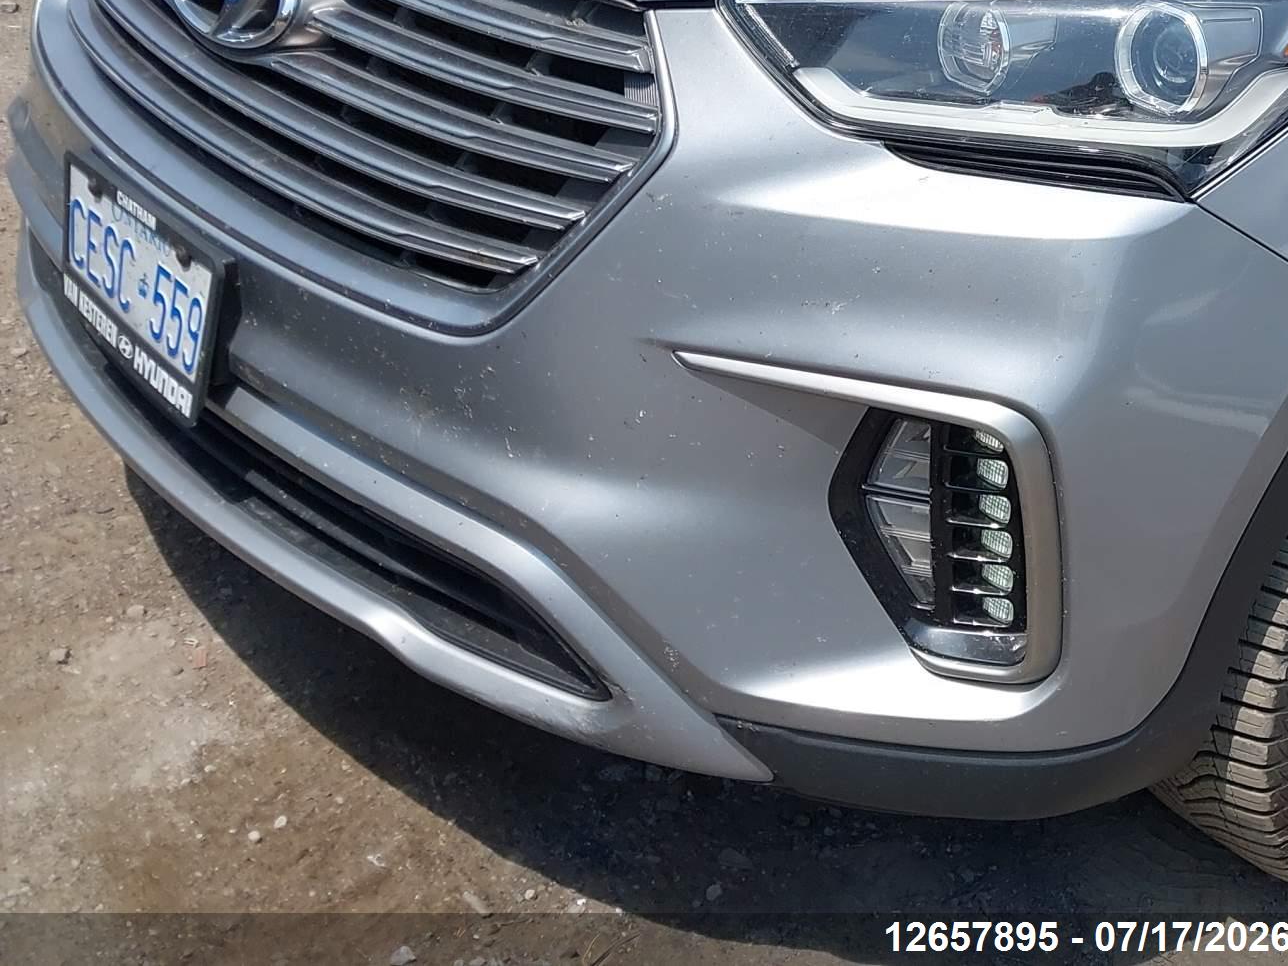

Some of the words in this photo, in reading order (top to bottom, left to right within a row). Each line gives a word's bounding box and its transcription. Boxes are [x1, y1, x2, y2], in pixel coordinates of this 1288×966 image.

[116, 190, 157, 232] CHATHAM
[63, 273, 79, 308] VAN
[133, 345, 193, 420] HYUNDAI
[69, 198, 136, 314] CESC
[149, 264, 203, 375] 559
